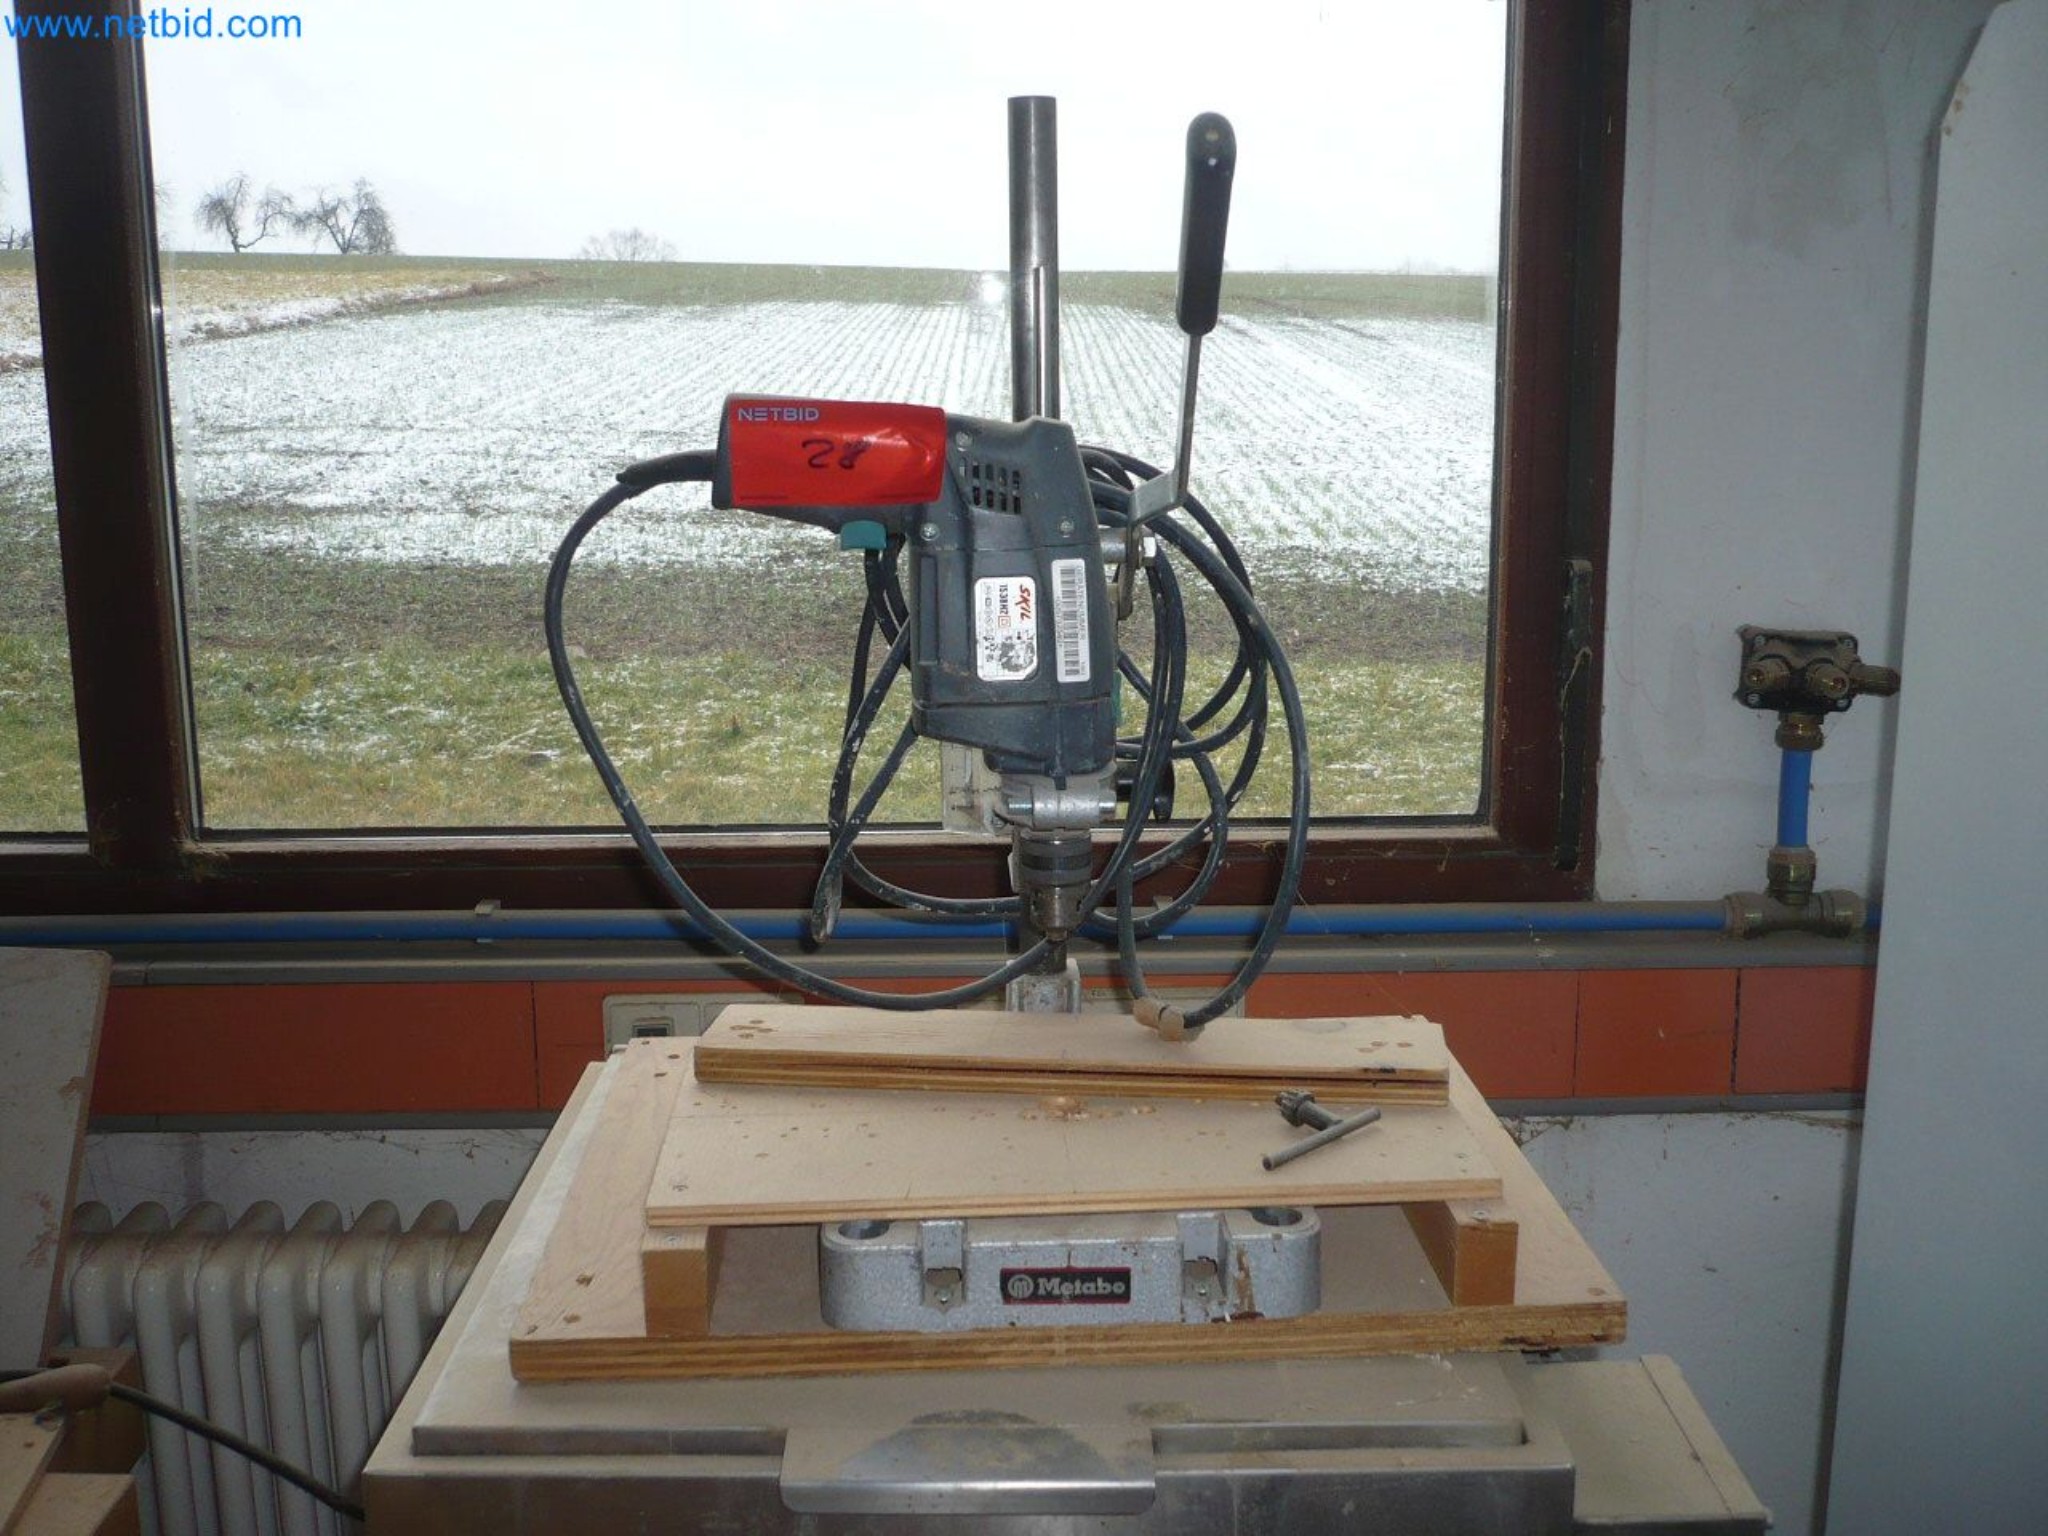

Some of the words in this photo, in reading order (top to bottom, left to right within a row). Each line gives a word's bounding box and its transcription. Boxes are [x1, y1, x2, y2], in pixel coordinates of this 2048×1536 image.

[738, 407, 820, 421] NETBID
[802, 439, 872, 469] 28
[1015, 584, 1031, 620] SKIL
[1037, 1277, 1125, 1295] Metabo
